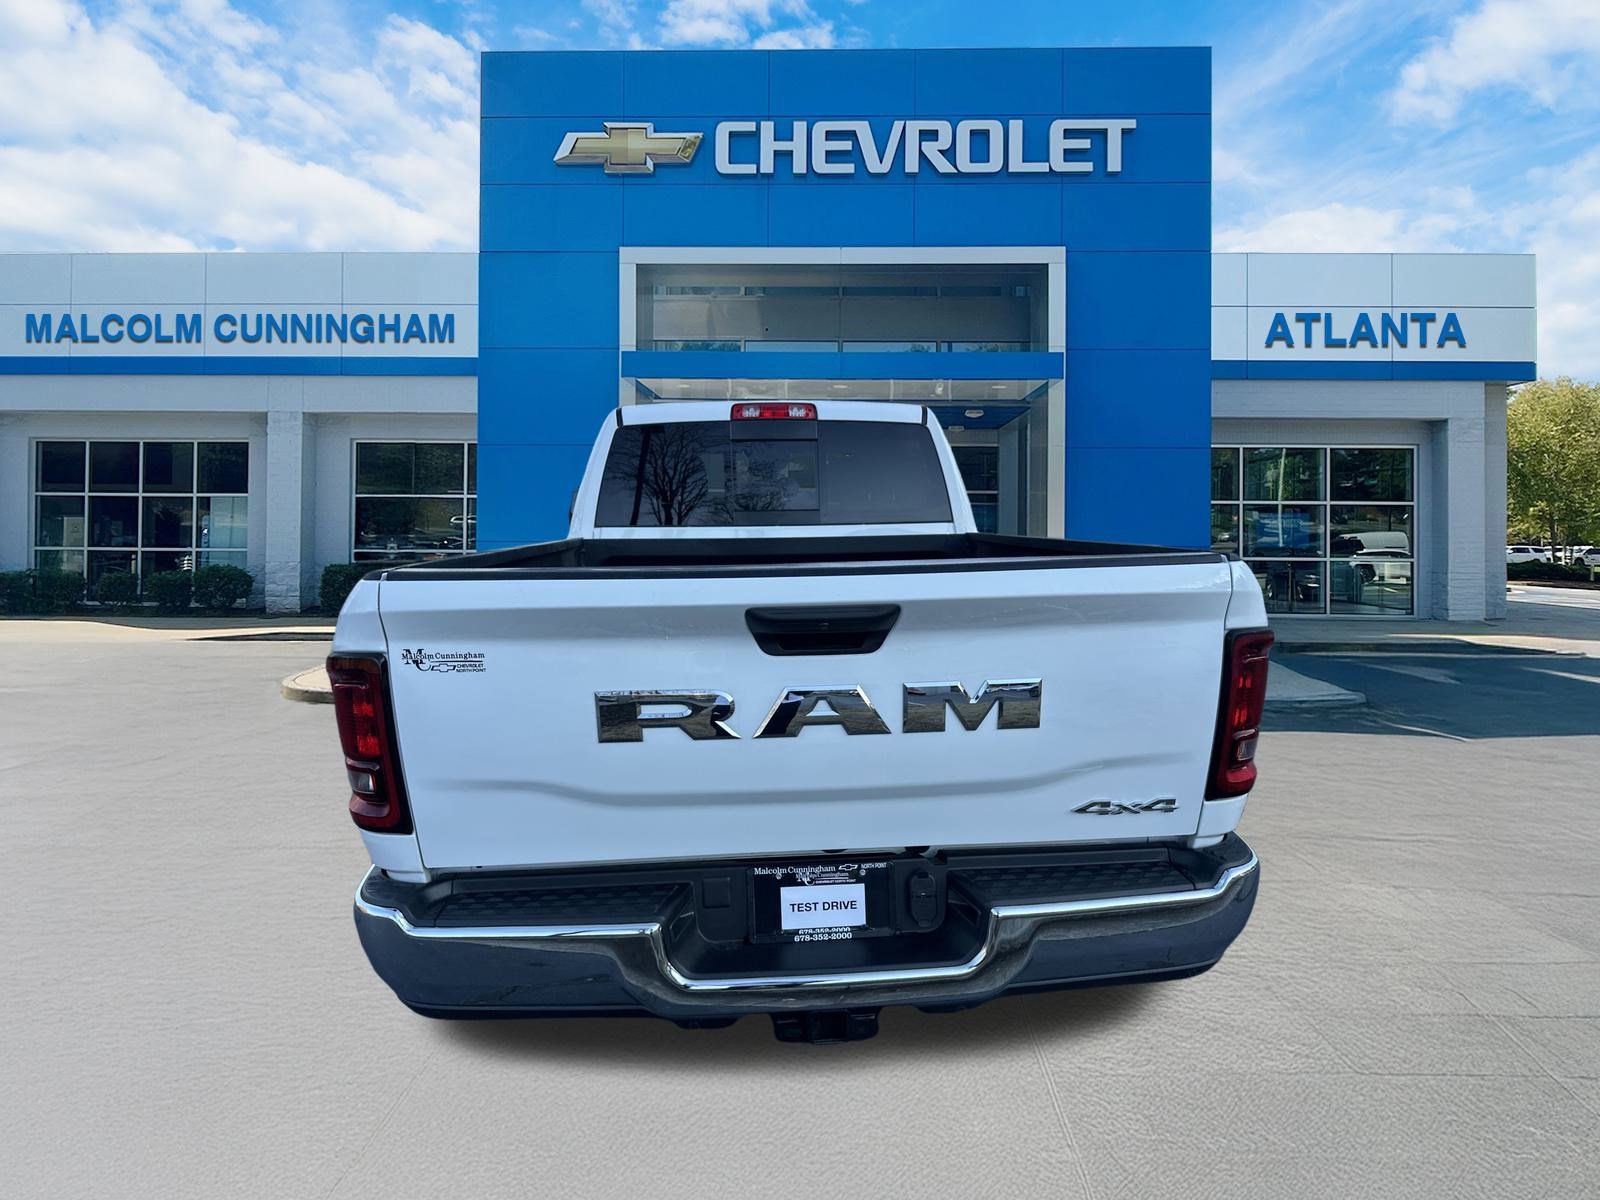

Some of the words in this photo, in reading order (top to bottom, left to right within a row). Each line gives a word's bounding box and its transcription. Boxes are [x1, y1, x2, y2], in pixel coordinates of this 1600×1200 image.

[714, 118, 1137, 175] CHEVROLET
[25, 313, 202, 344] MALCOLM
[214, 313, 455, 344] CUNNINGHAM
[1265, 312, 1466, 348] ATLANTA
[435, 652, 485, 660] Cunningham
[594, 677, 1042, 743] RAM
[754, 867, 787, 875] Malcolm
[788, 865, 836, 874] Cunningham
[790, 902, 819, 912] TEST
[822, 900, 857, 911] DRIVE
[794, 932, 852, 942] 678-352-2000
